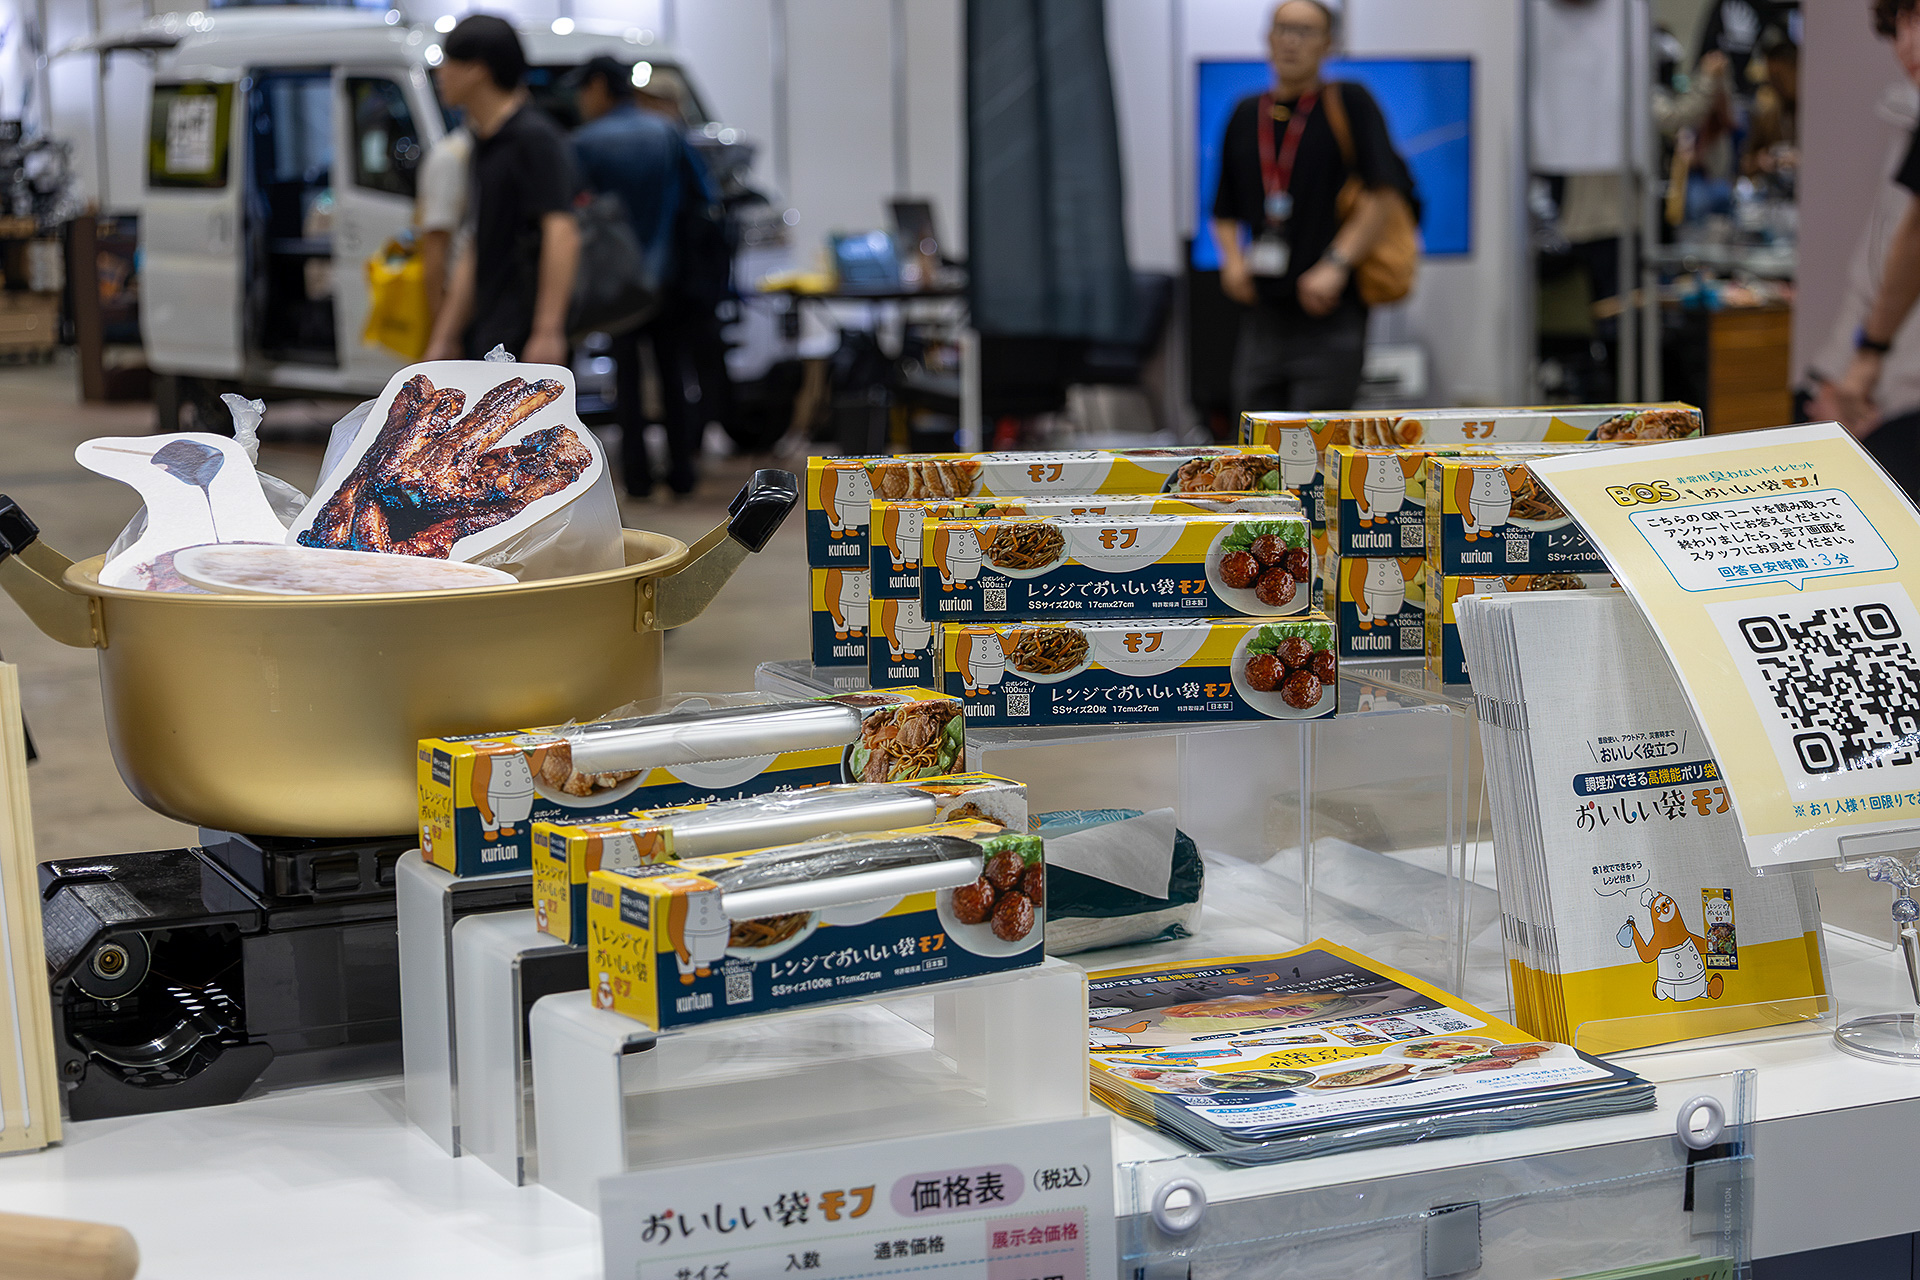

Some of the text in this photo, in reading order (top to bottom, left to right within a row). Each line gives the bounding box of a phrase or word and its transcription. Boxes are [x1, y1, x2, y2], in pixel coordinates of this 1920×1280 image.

[1461, 420, 1496, 439] モフ
[1027, 463, 1064, 483] モフ
[1605, 476, 1809, 506] BOS おいしい袋 モフ
[1098, 528, 1139, 549] モフ
[1352, 531, 1392, 549] kurilon
[828, 542, 860, 557] kurilon
[1461, 549, 1492, 564] kurilon
[1028, 578, 1206, 598] レンジでおいしい袋 モフ
[939, 597, 972, 612] kurilon
[1028, 600, 1083, 610] SSサイズ20枚
[1185, 599, 1204, 607] 日本製
[833, 643, 865, 658] kurilon
[1123, 631, 1163, 653] モフ
[1352, 633, 1391, 650] kurilon
[888, 665, 920, 679] kurilon
[1052, 681, 1232, 702] レンジでおいしい袋 モフ
[1052, 705, 1107, 715] SSサイズ20枚
[1600, 742, 1679, 763] おいしく役立つ
[1584, 763, 1717, 793] 調理ができる高機能ポリ袋
[1576, 789, 1687, 832] おいしい袋
[481, 844, 518, 863] kurilon
[771, 933, 946, 979] レンジでおいしい袋 モフ
[641, 1190, 810, 1245] おいしい袋
[818, 1184, 876, 1221] モフ
[910, 1171, 1005, 1212] 価格表
[785, 1250, 820, 1272] 入数
[873, 1235, 945, 1261] 通常価格
[992, 1223, 1079, 1249] 展示会価格
